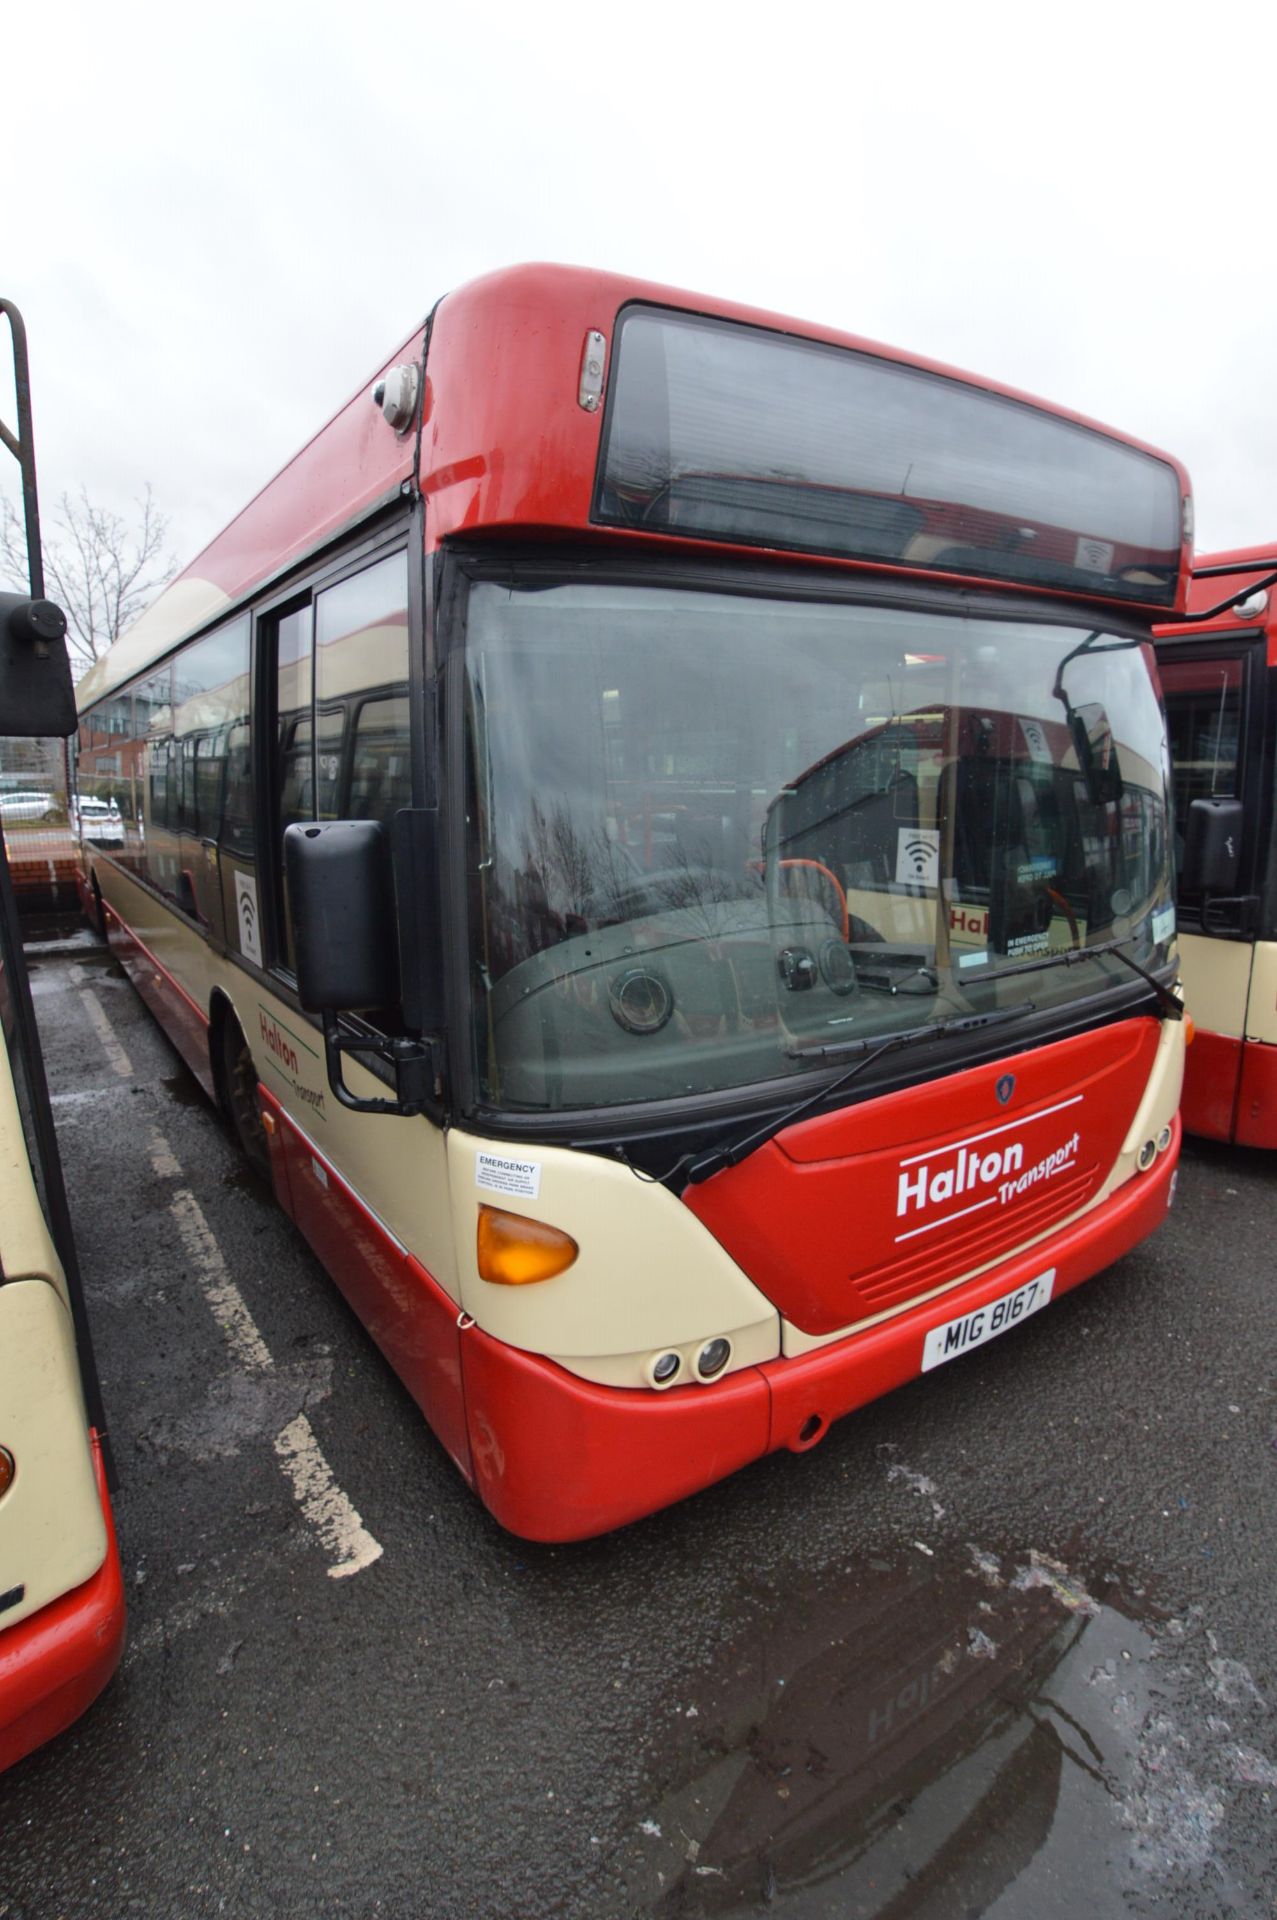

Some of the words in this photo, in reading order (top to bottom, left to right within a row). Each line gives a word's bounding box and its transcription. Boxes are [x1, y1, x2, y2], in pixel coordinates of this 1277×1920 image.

[259, 1010, 298, 1075] Halton
[479, 1155, 535, 1174] EMERGENCY
[896, 1142, 1023, 1217] Halton
[998, 1132, 1080, 1205] Transport
[944, 1316, 985, 1355] MIG
[990, 1281, 1039, 1333] 8167
